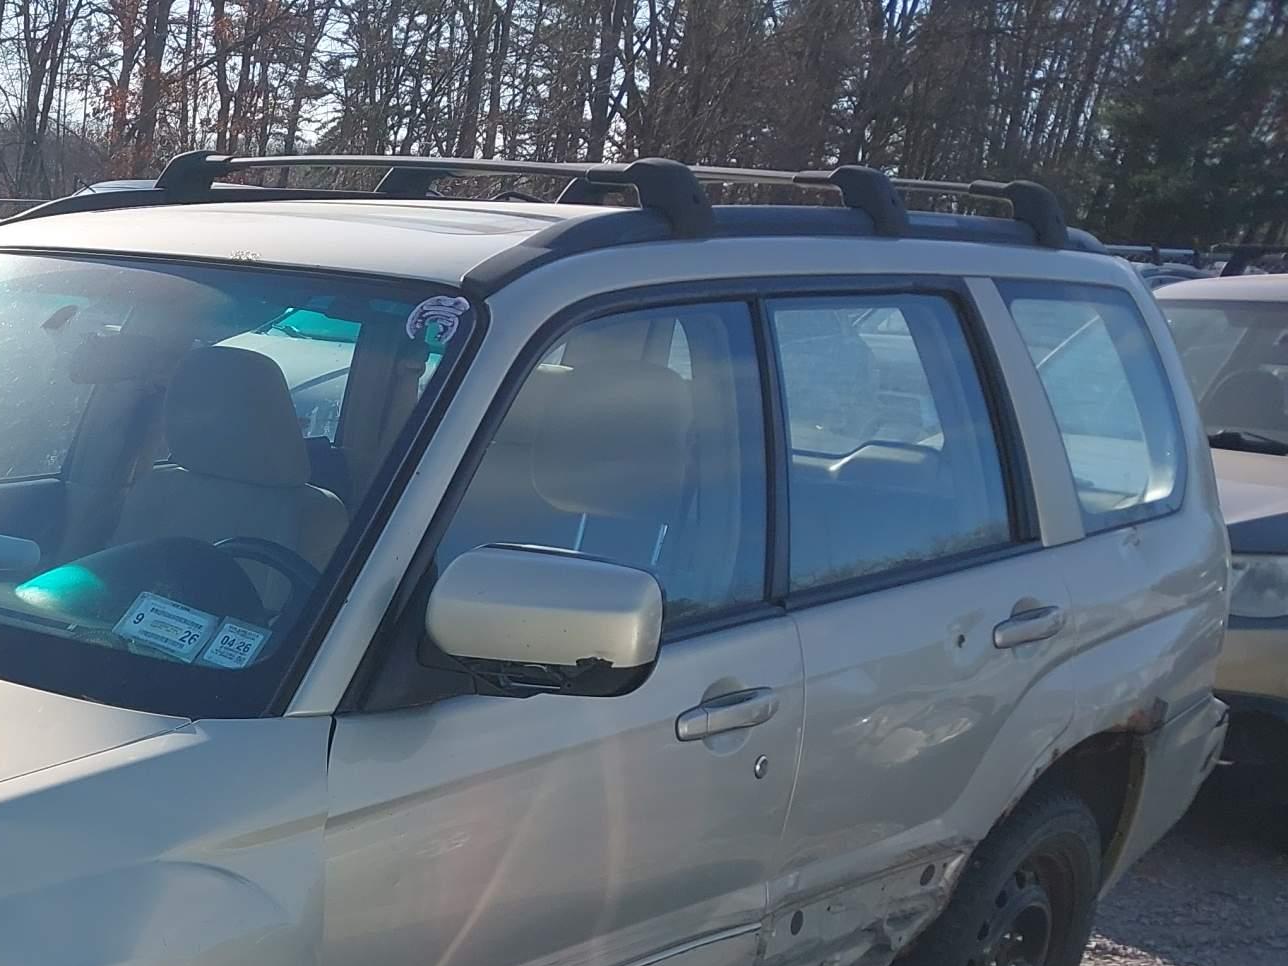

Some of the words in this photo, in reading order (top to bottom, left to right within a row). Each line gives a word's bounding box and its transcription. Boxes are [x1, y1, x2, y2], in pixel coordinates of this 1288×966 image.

[133, 612, 145, 625] 9
[178, 630, 200, 645] 26
[220, 635, 236, 647] 04
[236, 641, 252, 653] 26
